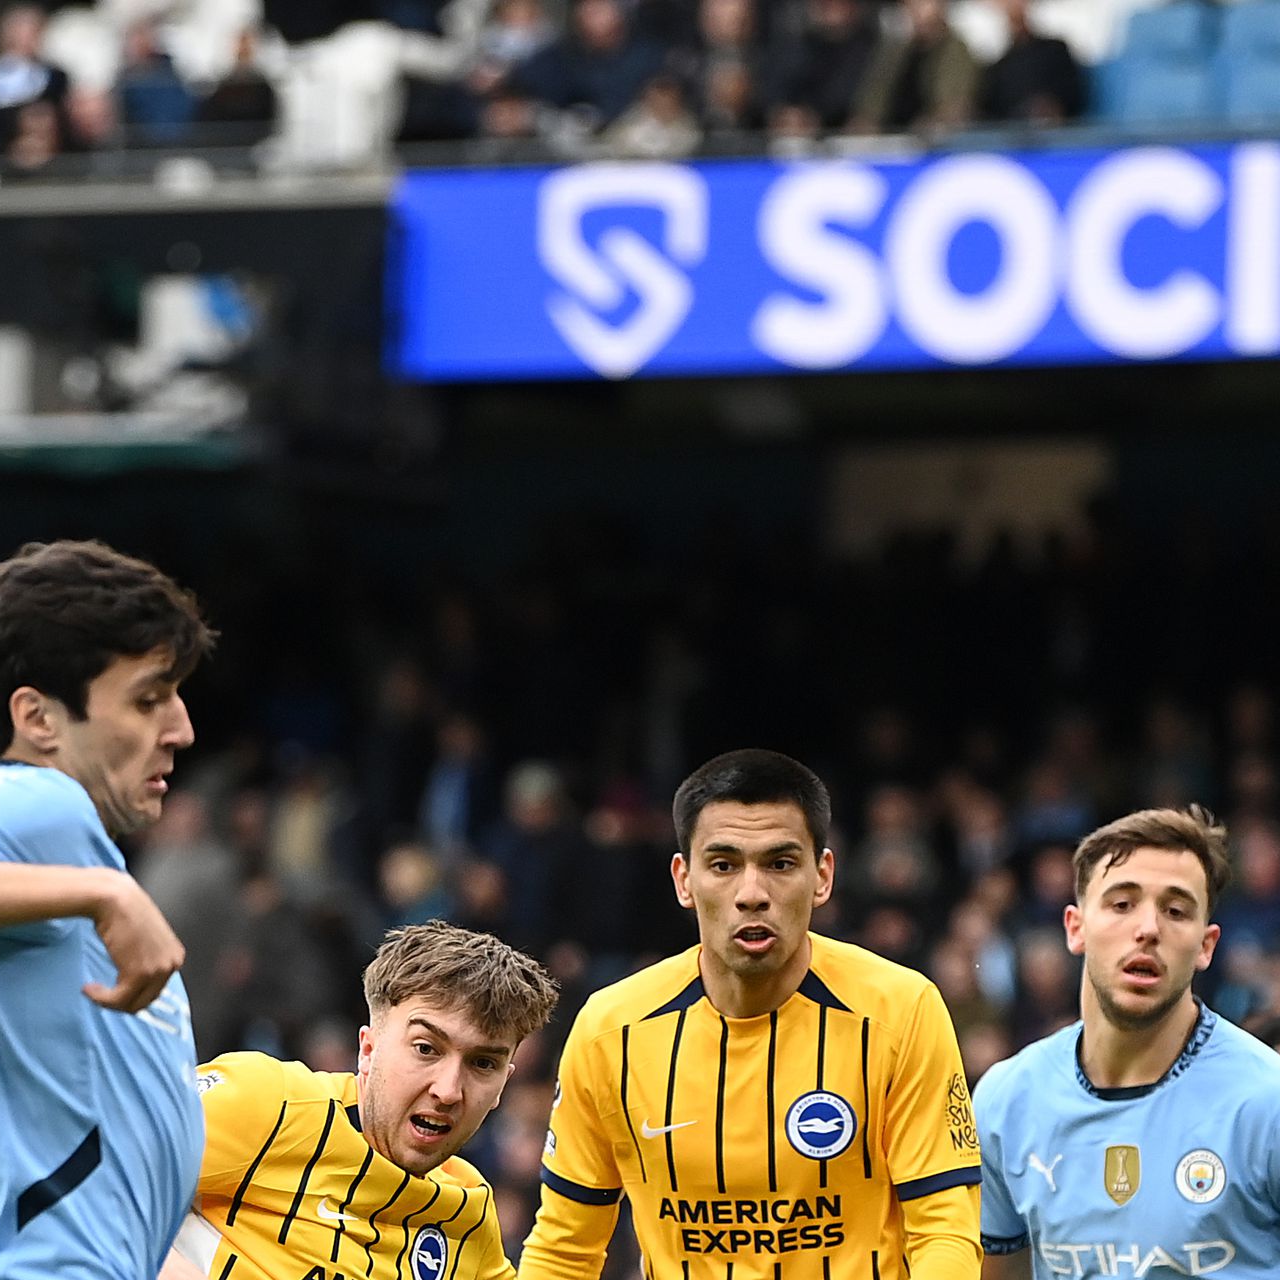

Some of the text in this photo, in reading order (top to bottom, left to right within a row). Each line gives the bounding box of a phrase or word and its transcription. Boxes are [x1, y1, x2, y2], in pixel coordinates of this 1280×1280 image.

[659, 1195, 842, 1225] AMERICAN
[682, 1222, 845, 1254] EXPRESS
[1040, 1240, 1236, 1278] ETIHAD
